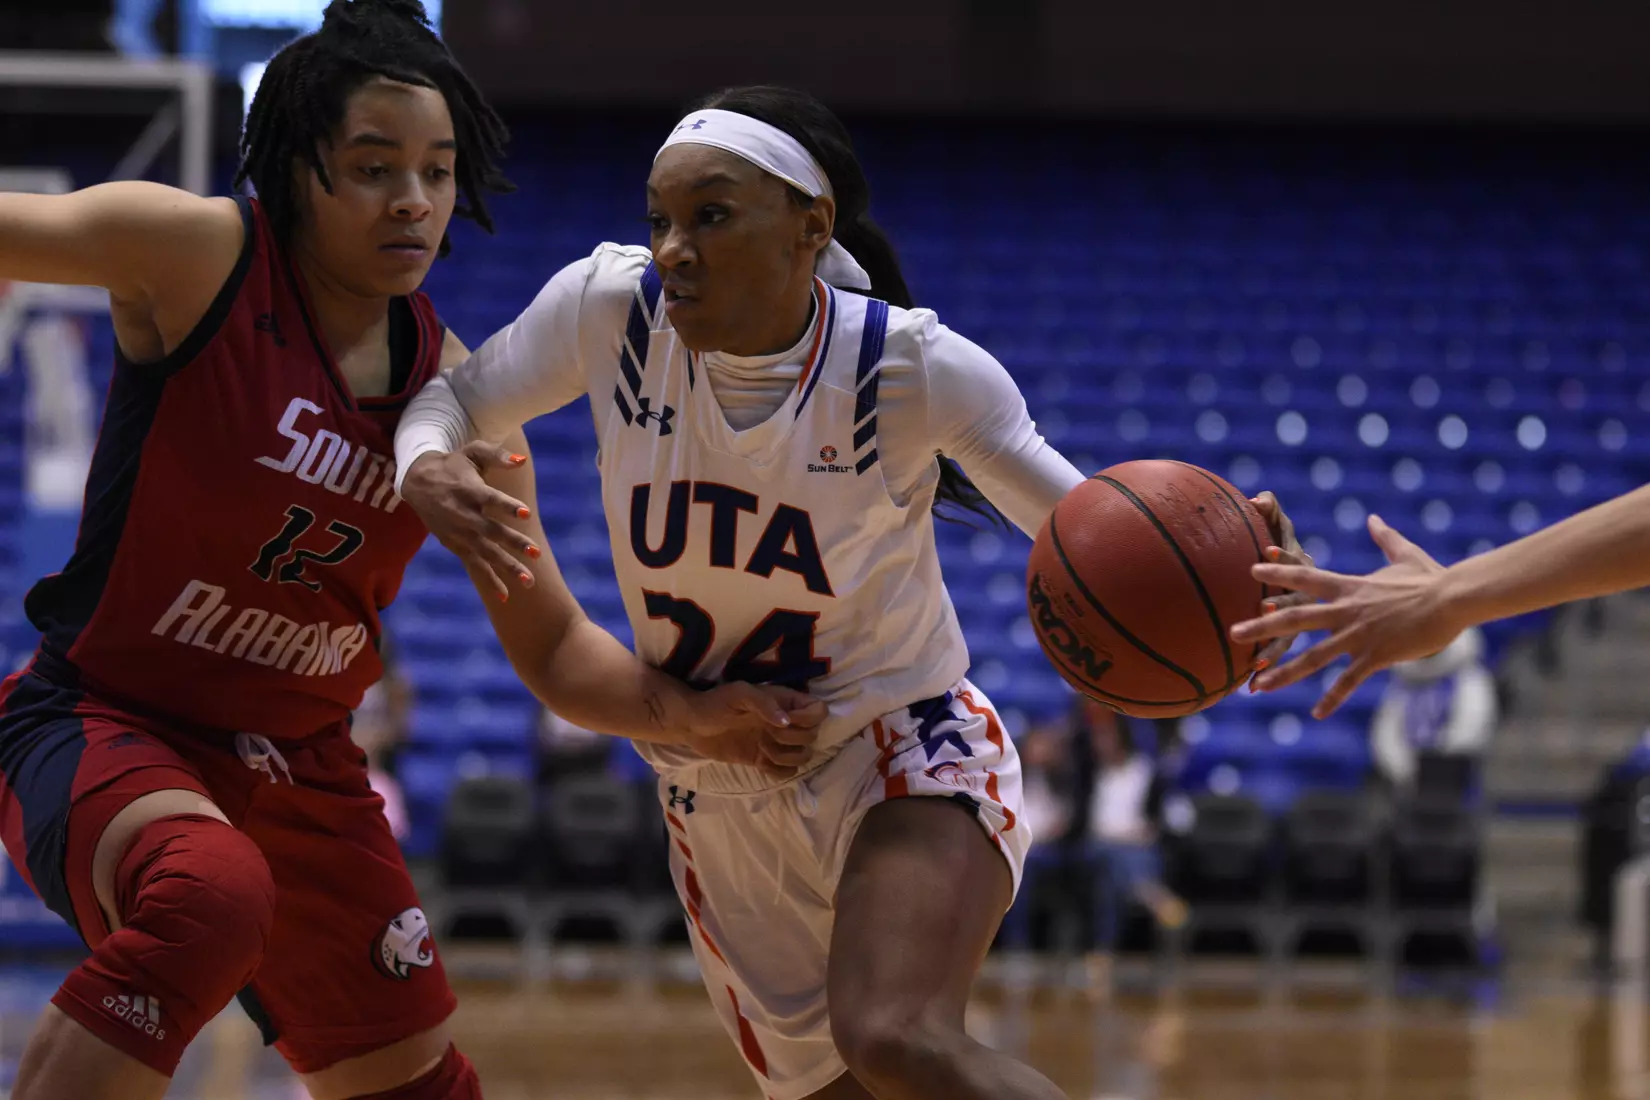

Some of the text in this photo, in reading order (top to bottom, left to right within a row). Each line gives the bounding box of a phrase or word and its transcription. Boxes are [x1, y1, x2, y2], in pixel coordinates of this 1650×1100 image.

[807, 464, 827, 473] SUN
[247, 503, 365, 593] 12
[629, 479, 837, 599] UTA
[151, 579, 368, 677] ALABAMA
[641, 586, 832, 694] 24
[1029, 572, 1113, 682] NCAA
[102, 995, 166, 1040] adidas
